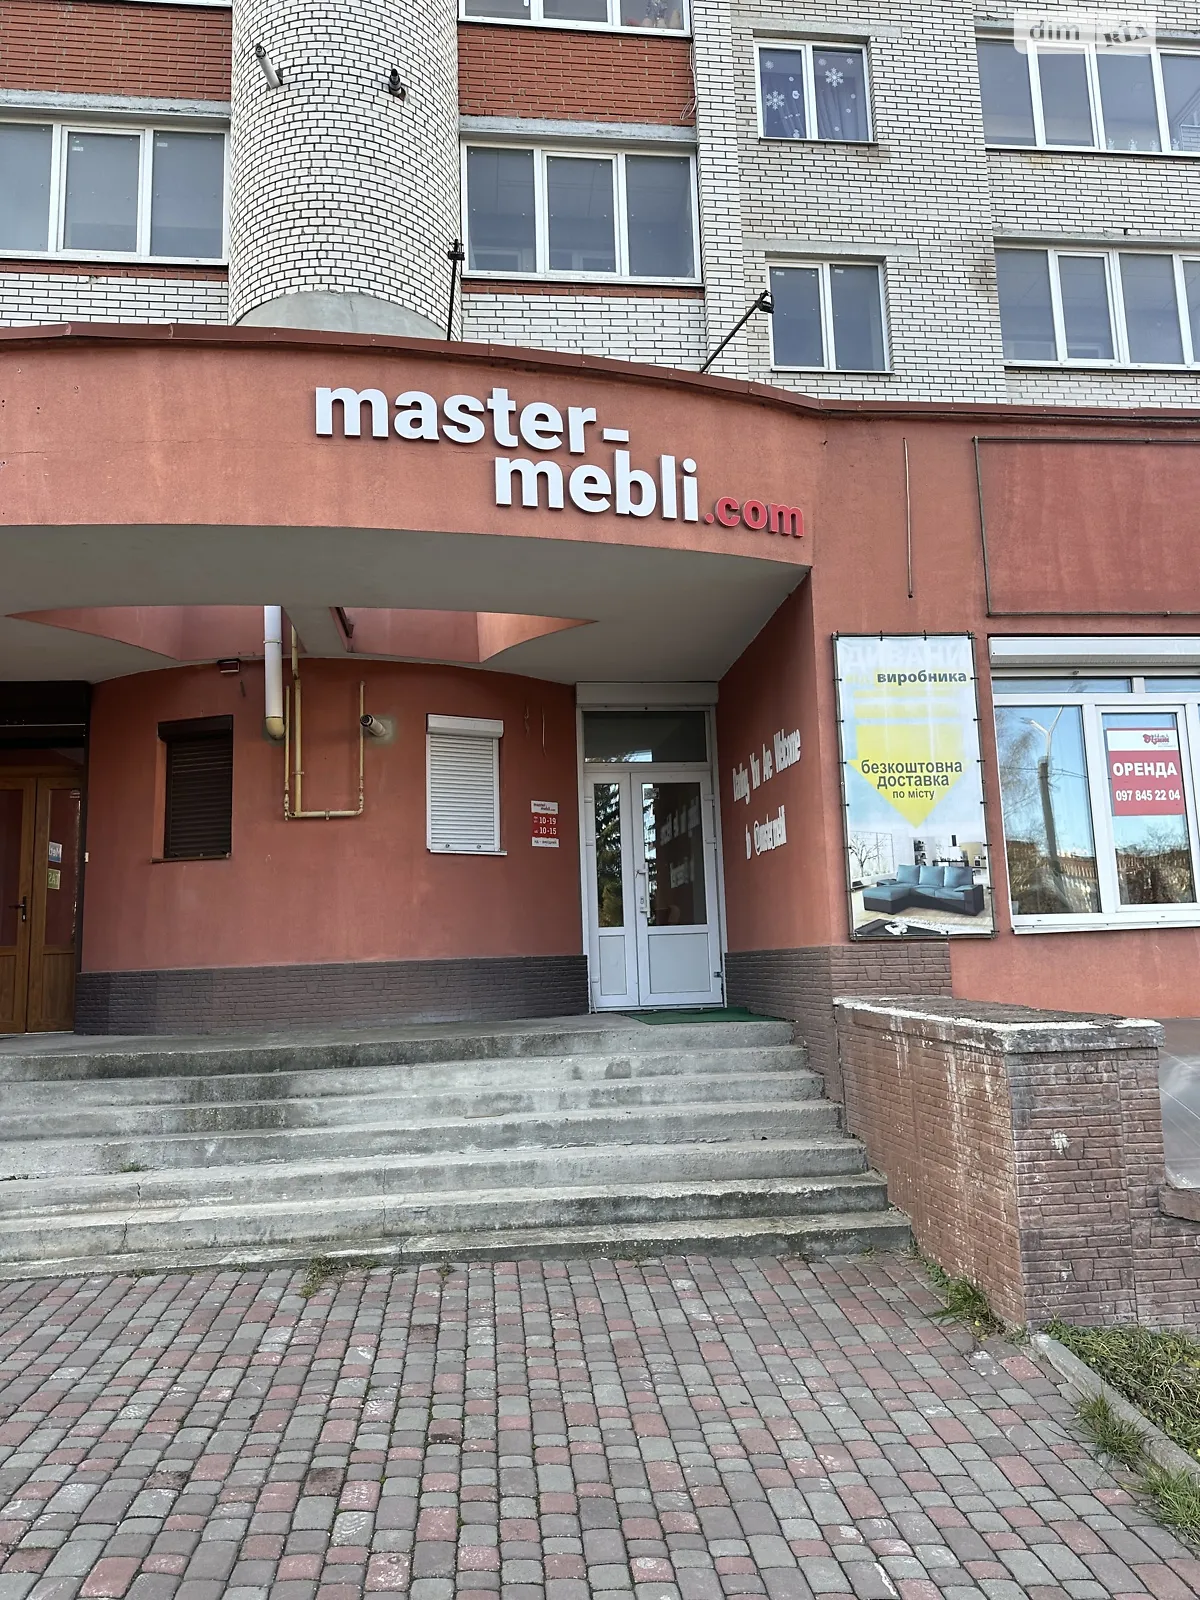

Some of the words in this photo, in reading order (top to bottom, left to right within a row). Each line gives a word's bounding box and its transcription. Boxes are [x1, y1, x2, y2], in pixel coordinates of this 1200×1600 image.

[315, 387, 629, 455] master-
[877, 670, 967, 686] виробника
[861, 759, 962, 774] безкоштовна
[1112, 762, 1178, 778] ОРЕНДА
[877, 774, 950, 789] доставка
[892, 790, 905, 799] по
[908, 789, 935, 800] місту
[1115, 790, 1133, 801] 097
[1135, 790, 1153, 801] 845
[1154, 789, 1167, 801] 22
[1168, 789, 1181, 801] 04
